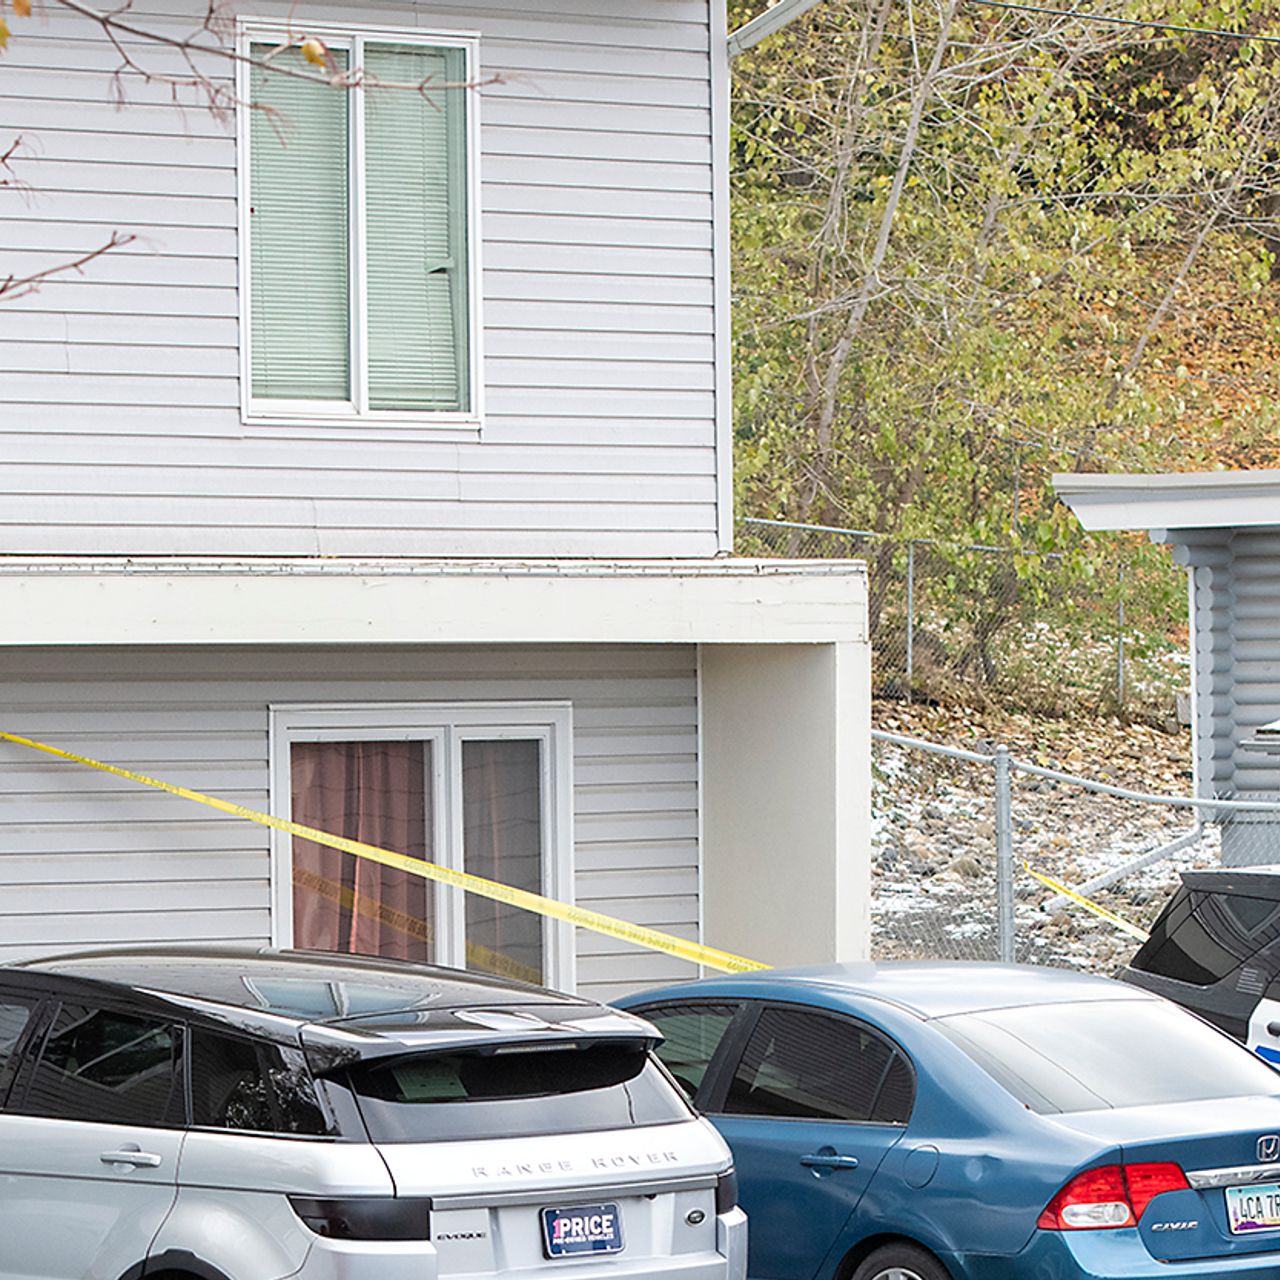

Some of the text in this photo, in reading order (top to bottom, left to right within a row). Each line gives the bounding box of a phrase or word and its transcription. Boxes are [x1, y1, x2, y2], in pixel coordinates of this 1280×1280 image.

[472, 1152, 679, 1178] RANGE ROVER
[1239, 1195, 1264, 1219] 4CA
[1151, 1220, 1199, 1232] CIVIC
[437, 1232, 487, 1242] EVOQUE
